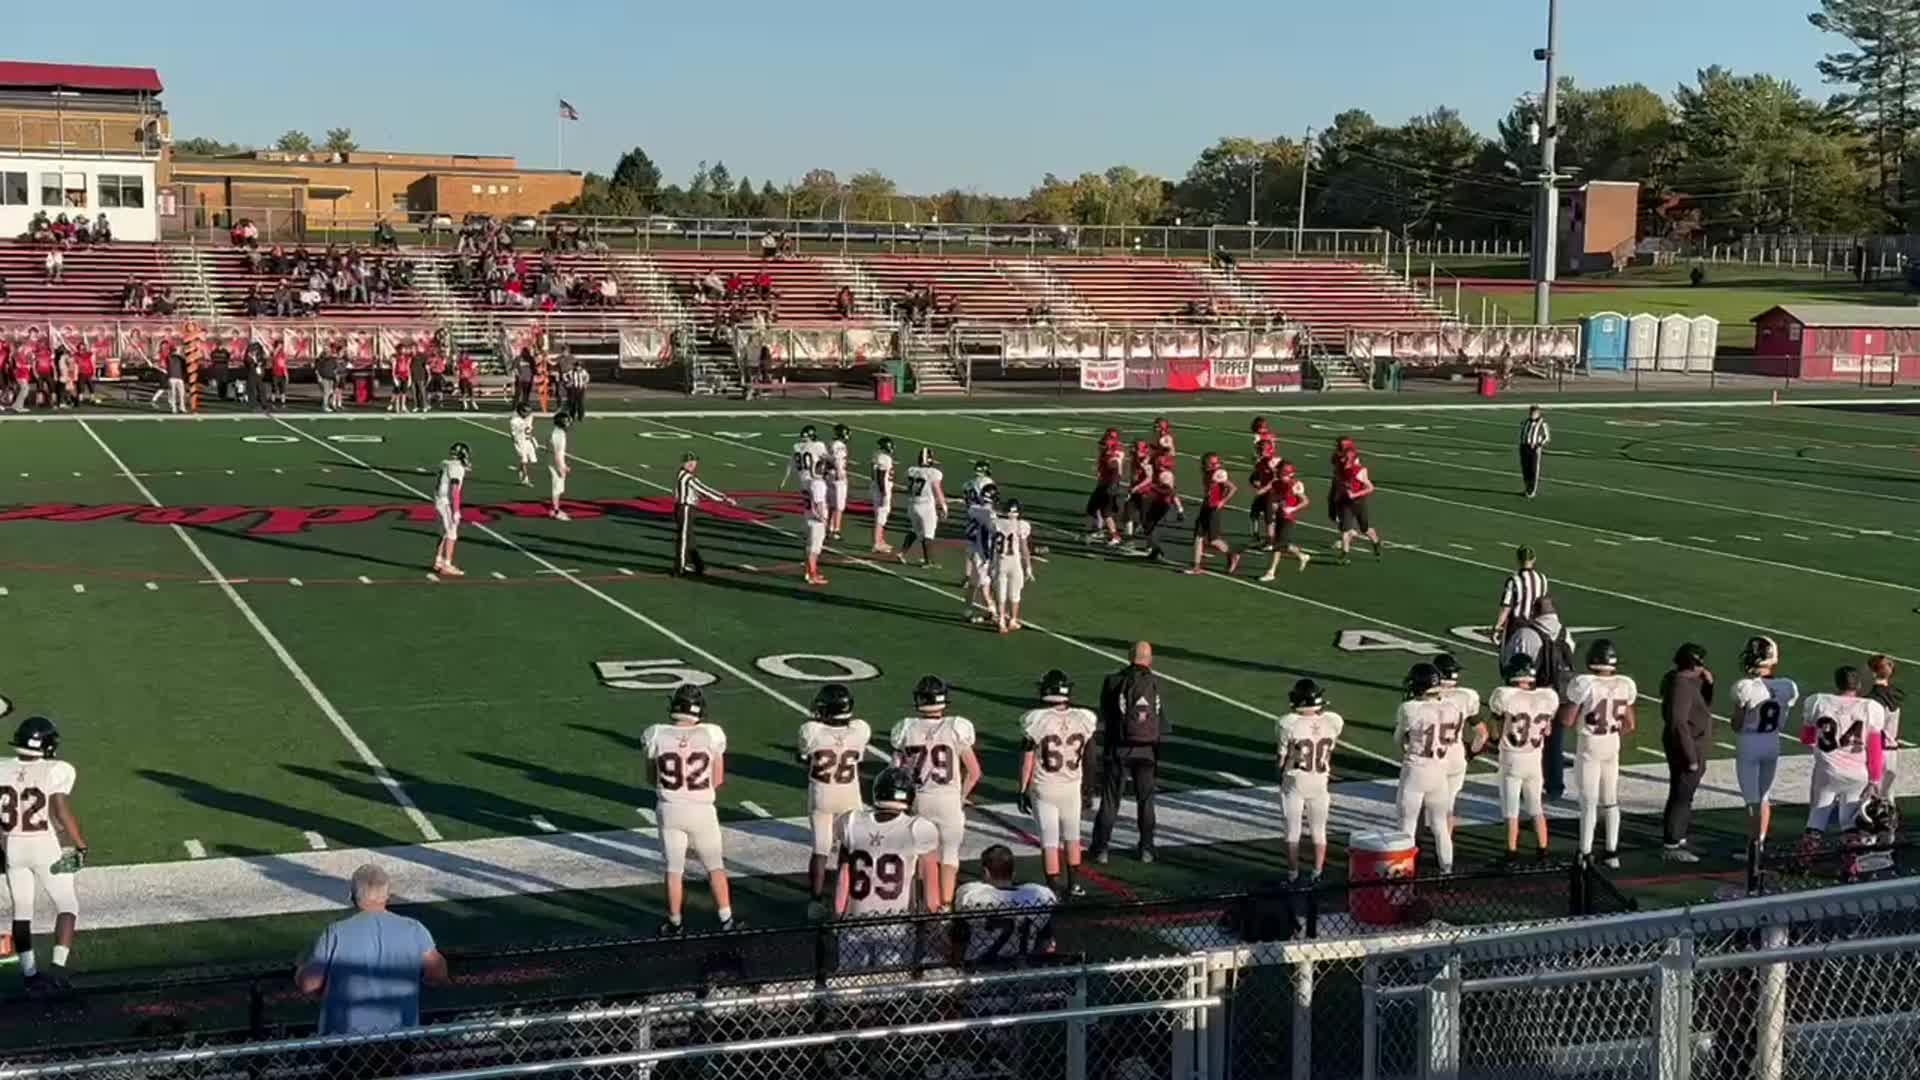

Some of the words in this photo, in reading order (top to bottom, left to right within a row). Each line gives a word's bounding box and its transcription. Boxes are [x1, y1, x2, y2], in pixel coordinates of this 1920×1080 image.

[1585, 698, 1627, 735] 45
[1757, 701, 1780, 733] 8
[657, 752, 710, 791] 92
[810, 749, 860, 784] 26
[1039, 734, 1086, 773] 63
[849, 850, 904, 901] 69
